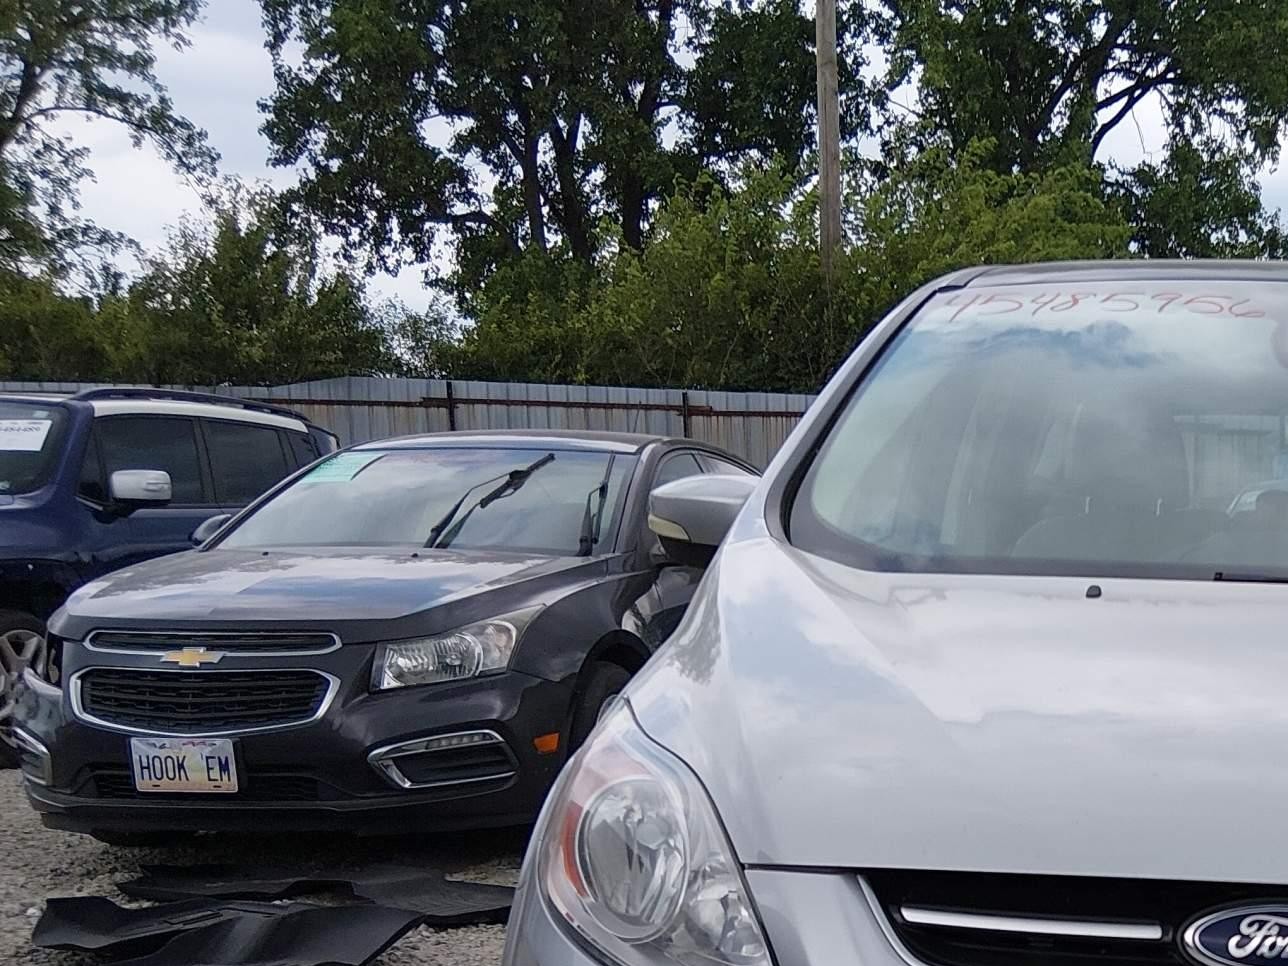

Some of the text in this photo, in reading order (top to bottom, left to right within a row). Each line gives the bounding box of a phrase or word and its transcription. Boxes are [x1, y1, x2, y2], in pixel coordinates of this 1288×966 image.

[945, 291, 1266, 322] 45485956
[138, 753, 232, 783] HOOK 'EM
